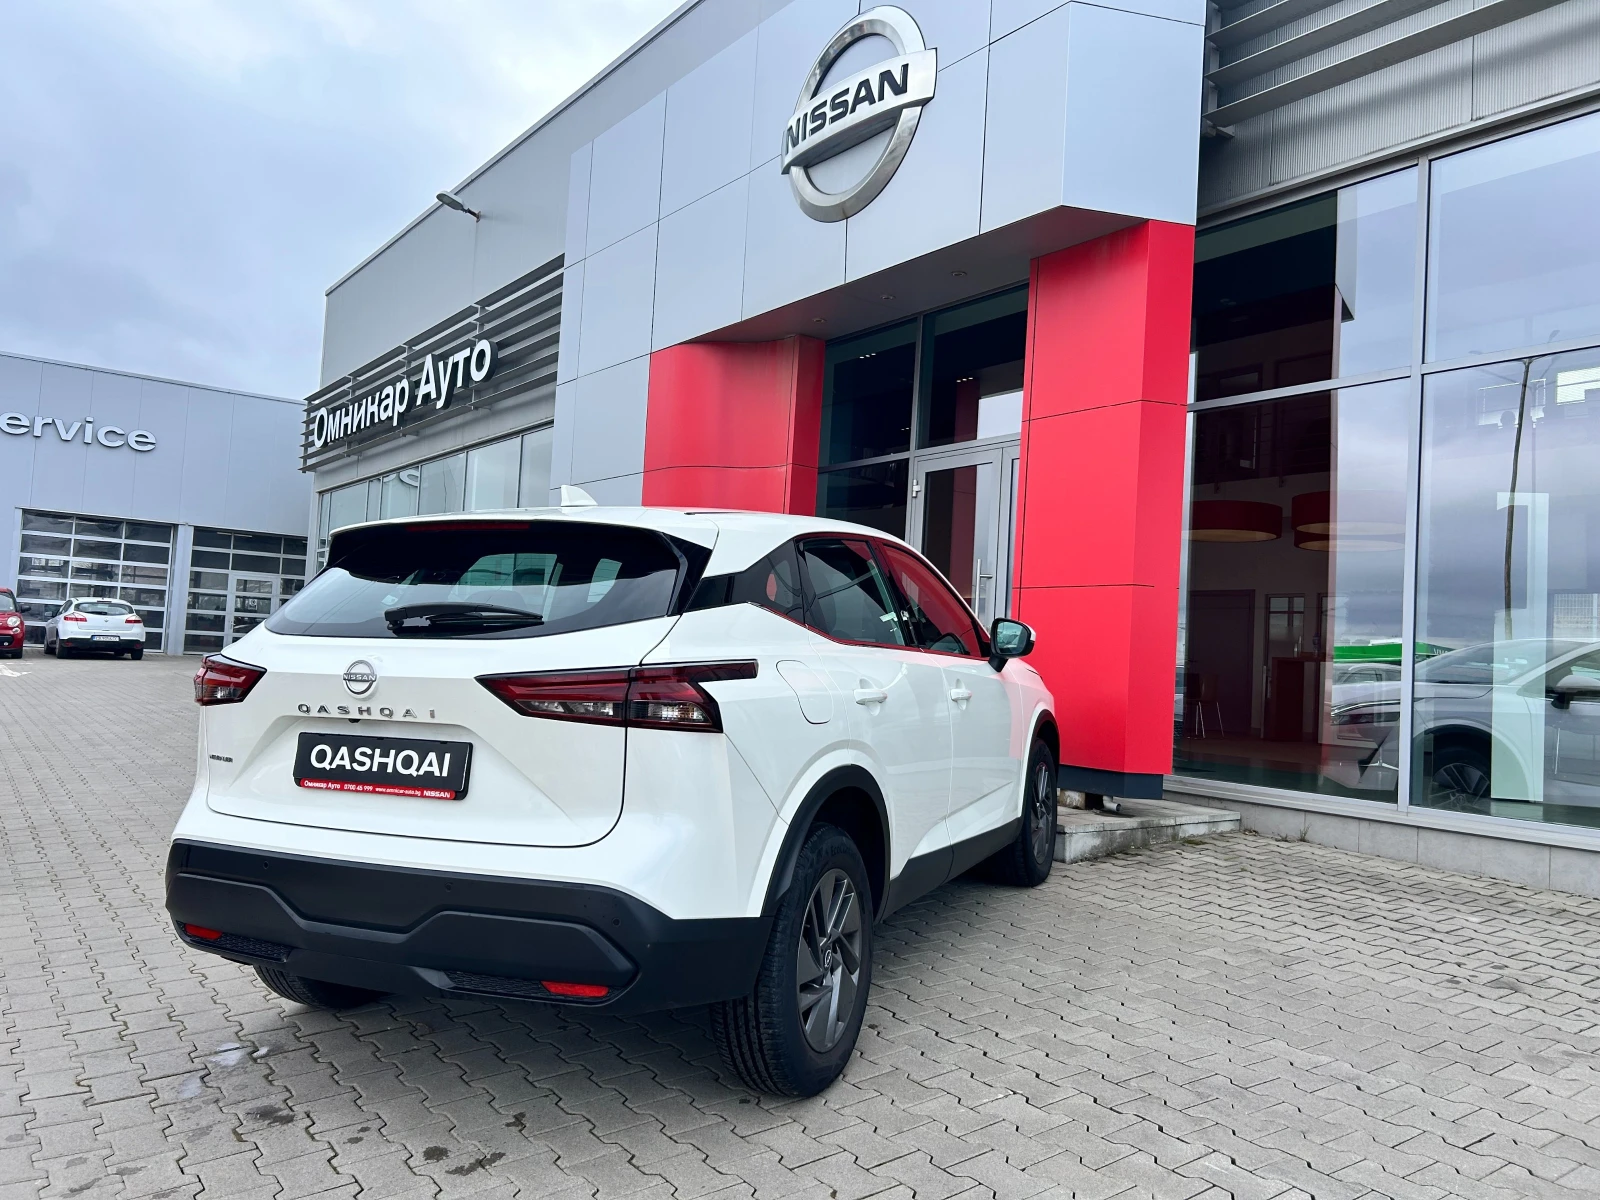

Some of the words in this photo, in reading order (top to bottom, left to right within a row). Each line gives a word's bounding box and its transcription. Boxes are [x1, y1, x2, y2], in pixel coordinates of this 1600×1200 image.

[785, 63, 909, 156] NISSAN
[314, 379, 409, 448] Омникар
[416, 339, 492, 409] Ауто
[298, 703, 436, 719] QASHQAI
[310, 744, 451, 777] QASHQAI
